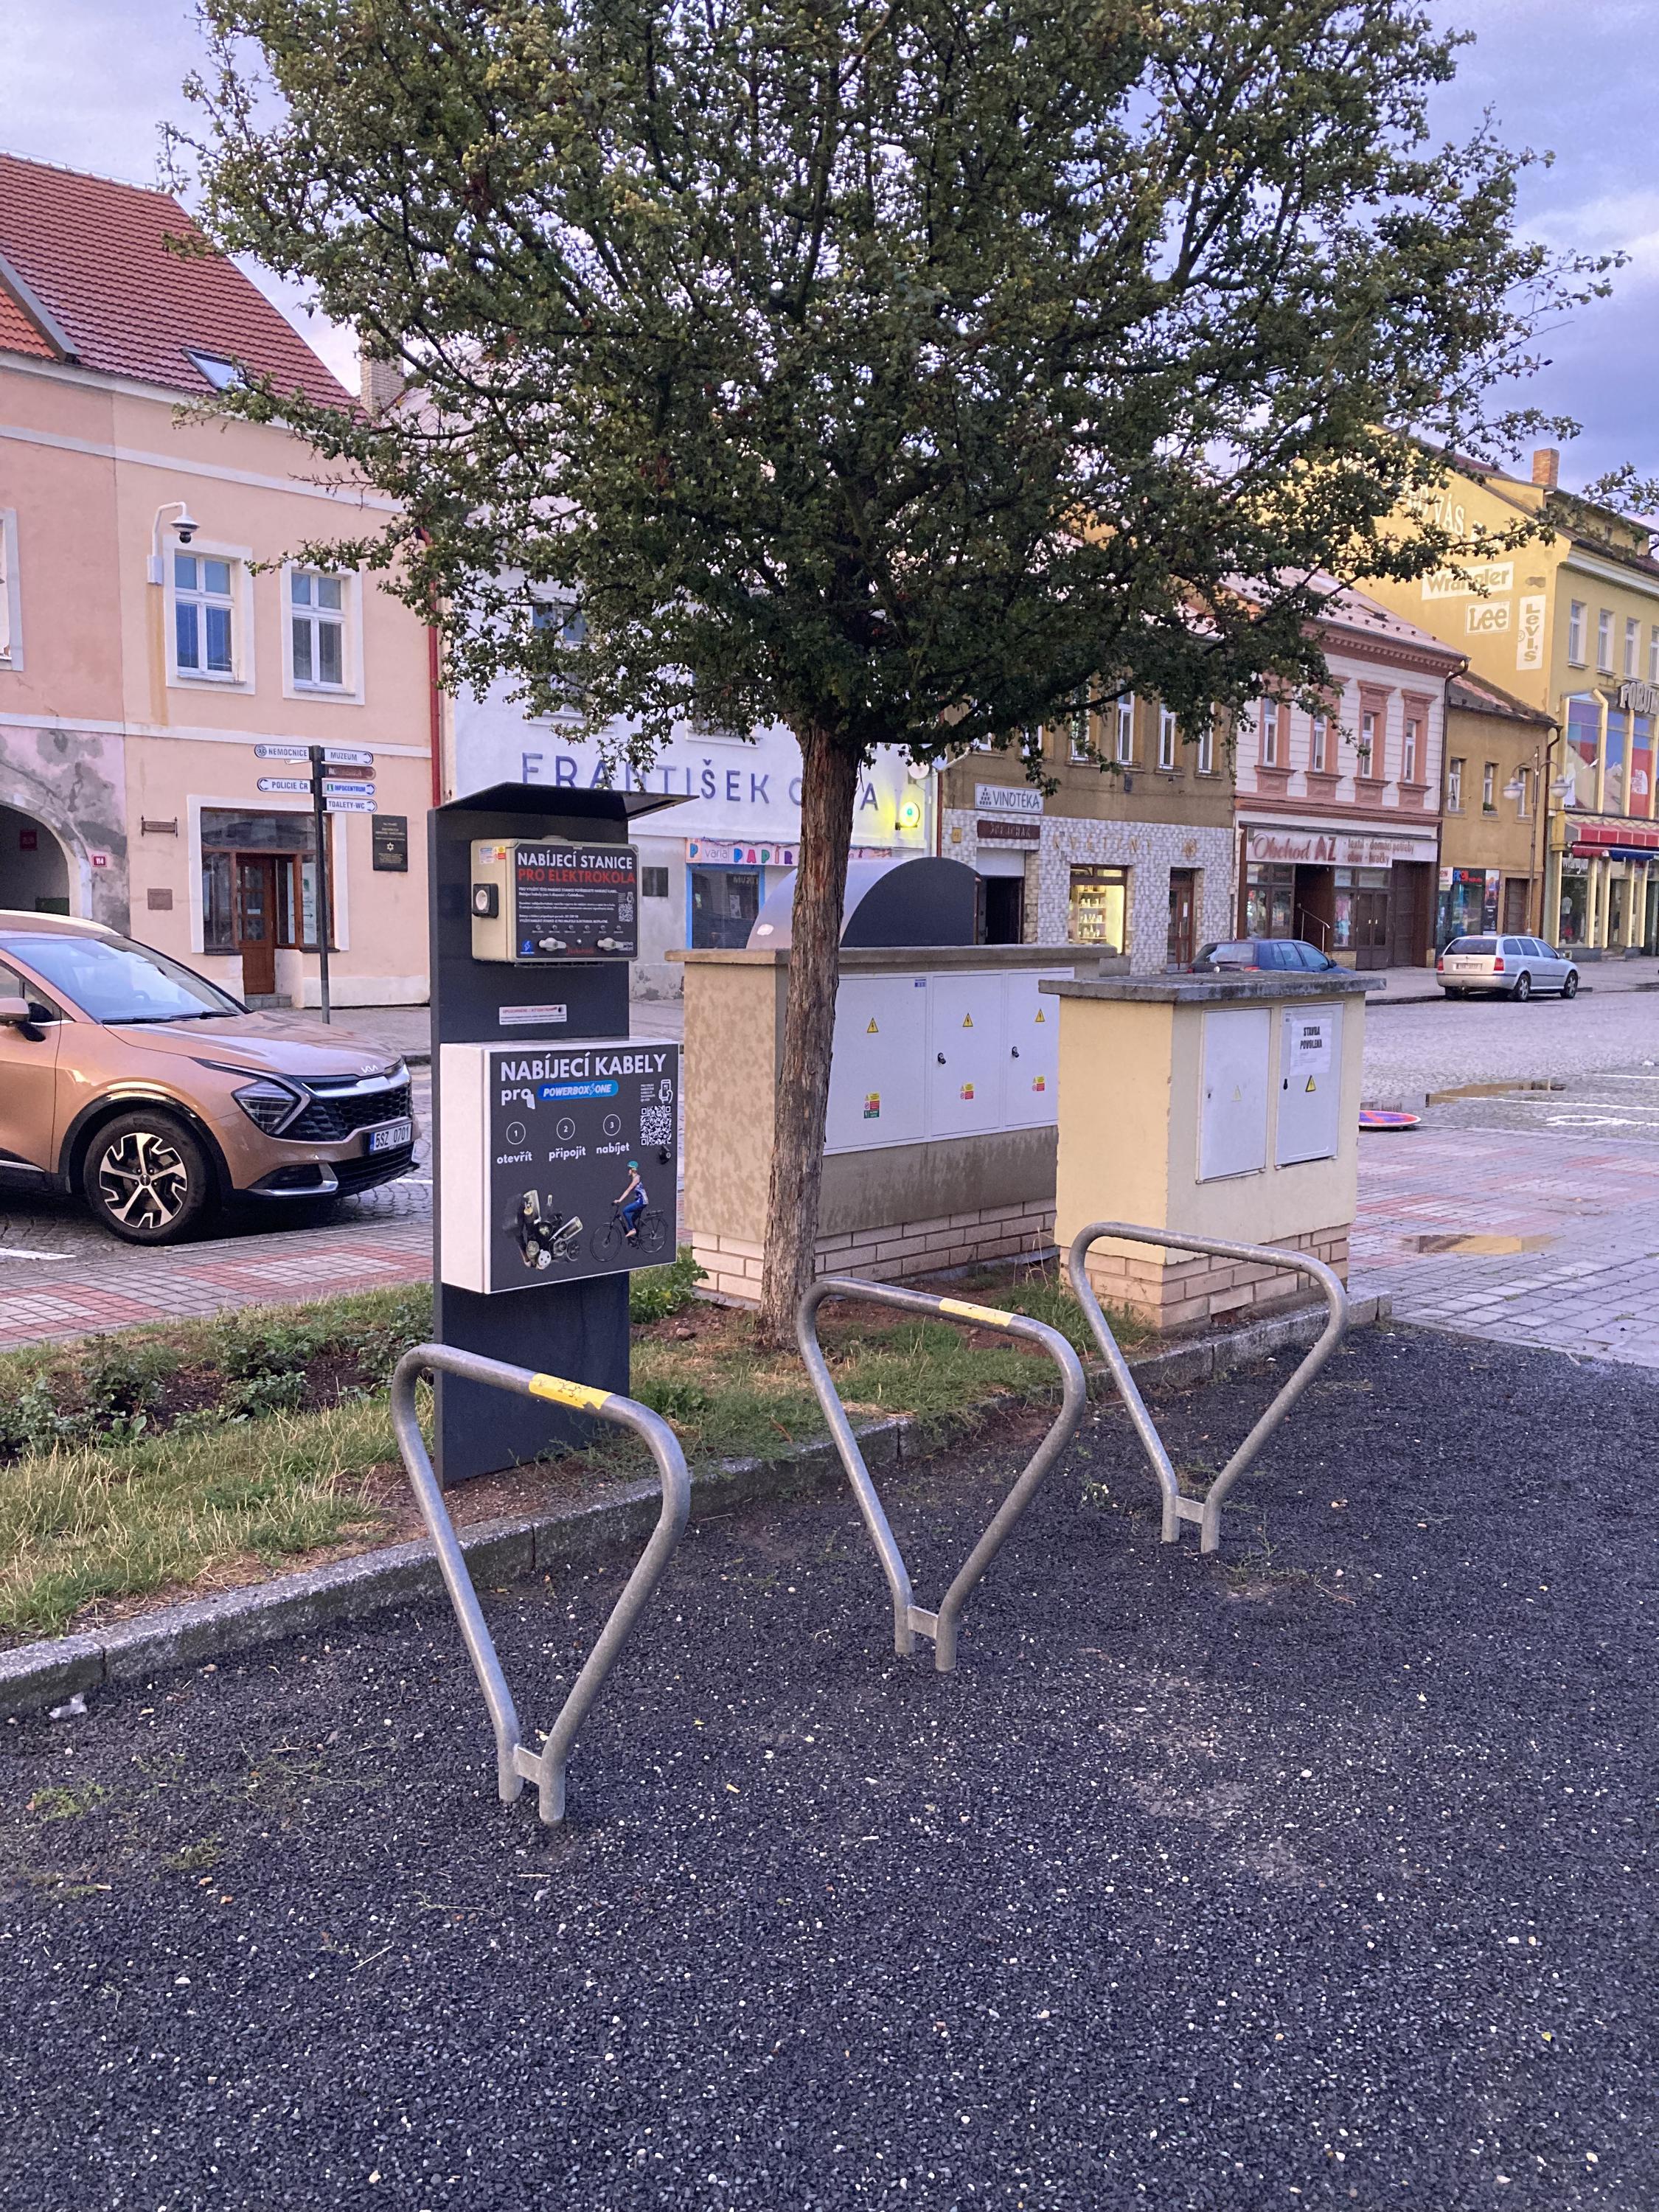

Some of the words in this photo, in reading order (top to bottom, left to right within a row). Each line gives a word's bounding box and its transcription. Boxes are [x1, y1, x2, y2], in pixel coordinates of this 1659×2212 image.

[1469, 608, 1507, 632] Lee
[268, 748, 307, 757] NEMOCNICE
[330, 752, 358, 762] MUZEUM
[271, 781, 297, 790] POLICIE
[299, 780, 308, 790] ČR
[992, 790, 1040, 809] VINOTÉKA
[733, 846, 793, 865] PAPÍR
[1252, 833, 1311, 860] Obchod
[1315, 835, 1336, 861] AZ
[518, 850, 577, 868] NABÍJECÍ
[580, 855, 633, 869] STANICE
[518, 869, 545, 882] PRO
[548, 869, 636, 884] ELEKTROKOLA
[501, 1051, 590, 1082] NABÍJECÍ
[595, 1054, 667, 1077] KABELY
[501, 1088, 532, 1106] pro
[375, 1131, 389, 1148] 5SZ
[393, 1124, 409, 1143] 0701
[496, 1152, 532, 1164] otevřít
[549, 1146, 586, 1161] připojit
[596, 1141, 630, 1155] nabíjet
